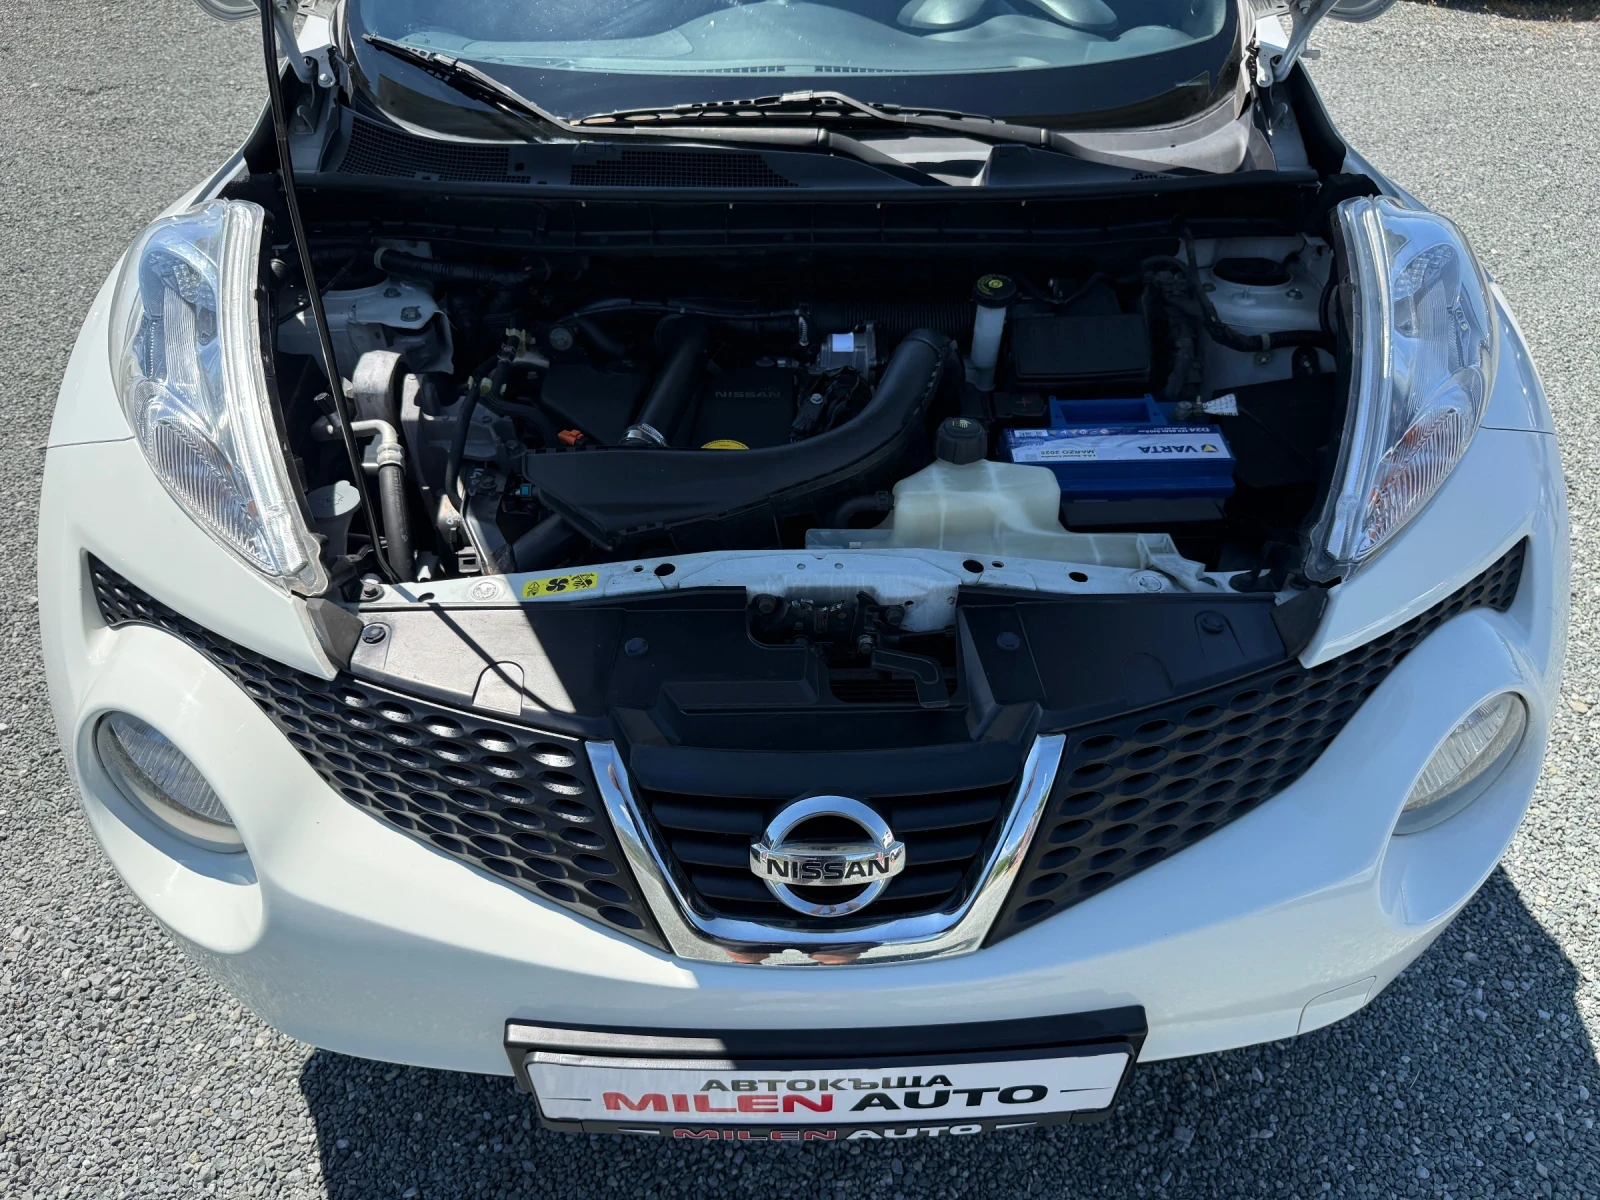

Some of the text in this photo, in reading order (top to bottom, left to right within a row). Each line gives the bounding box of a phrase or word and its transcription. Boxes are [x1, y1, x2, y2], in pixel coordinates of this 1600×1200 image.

[1137, 445, 1199, 454] VARTA
[767, 857, 890, 880] NISSAN
[602, 1085, 1049, 1113] MILEN AUTO
[673, 1124, 982, 1141] MILEN AUTO
